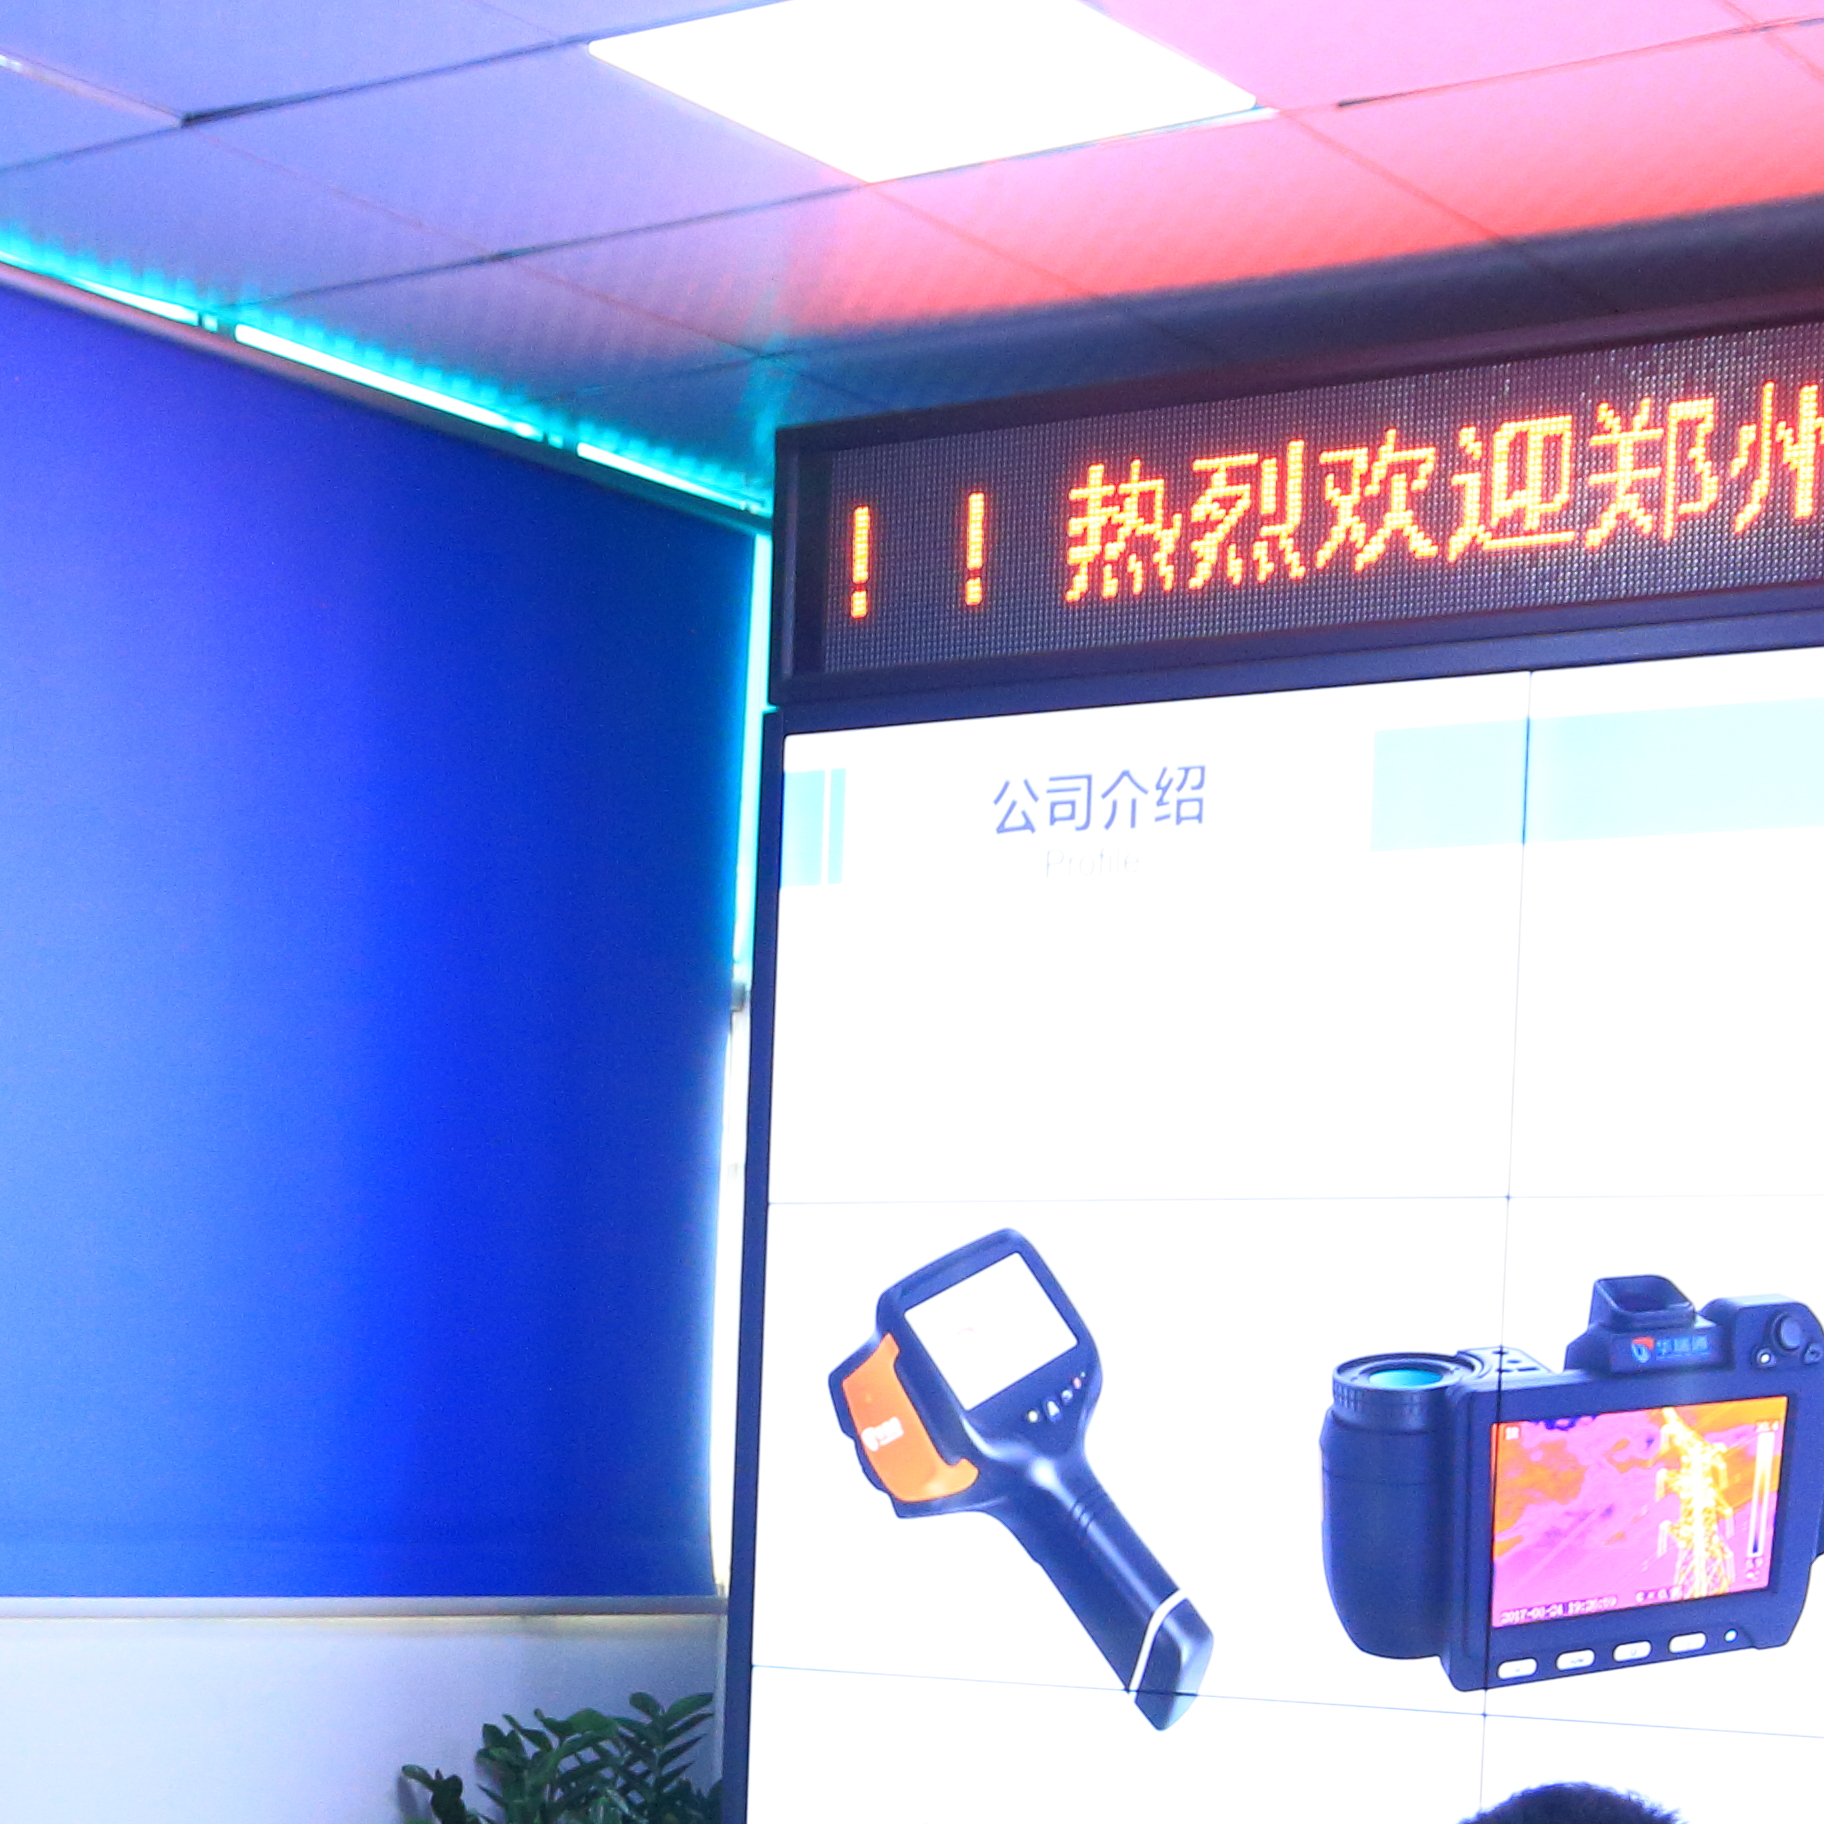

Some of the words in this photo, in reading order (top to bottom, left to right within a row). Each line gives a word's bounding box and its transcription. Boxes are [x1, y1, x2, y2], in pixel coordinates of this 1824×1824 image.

[992, 764, 1206, 836] 公司介绍
[1045, 846, 1141, 878] Profile
